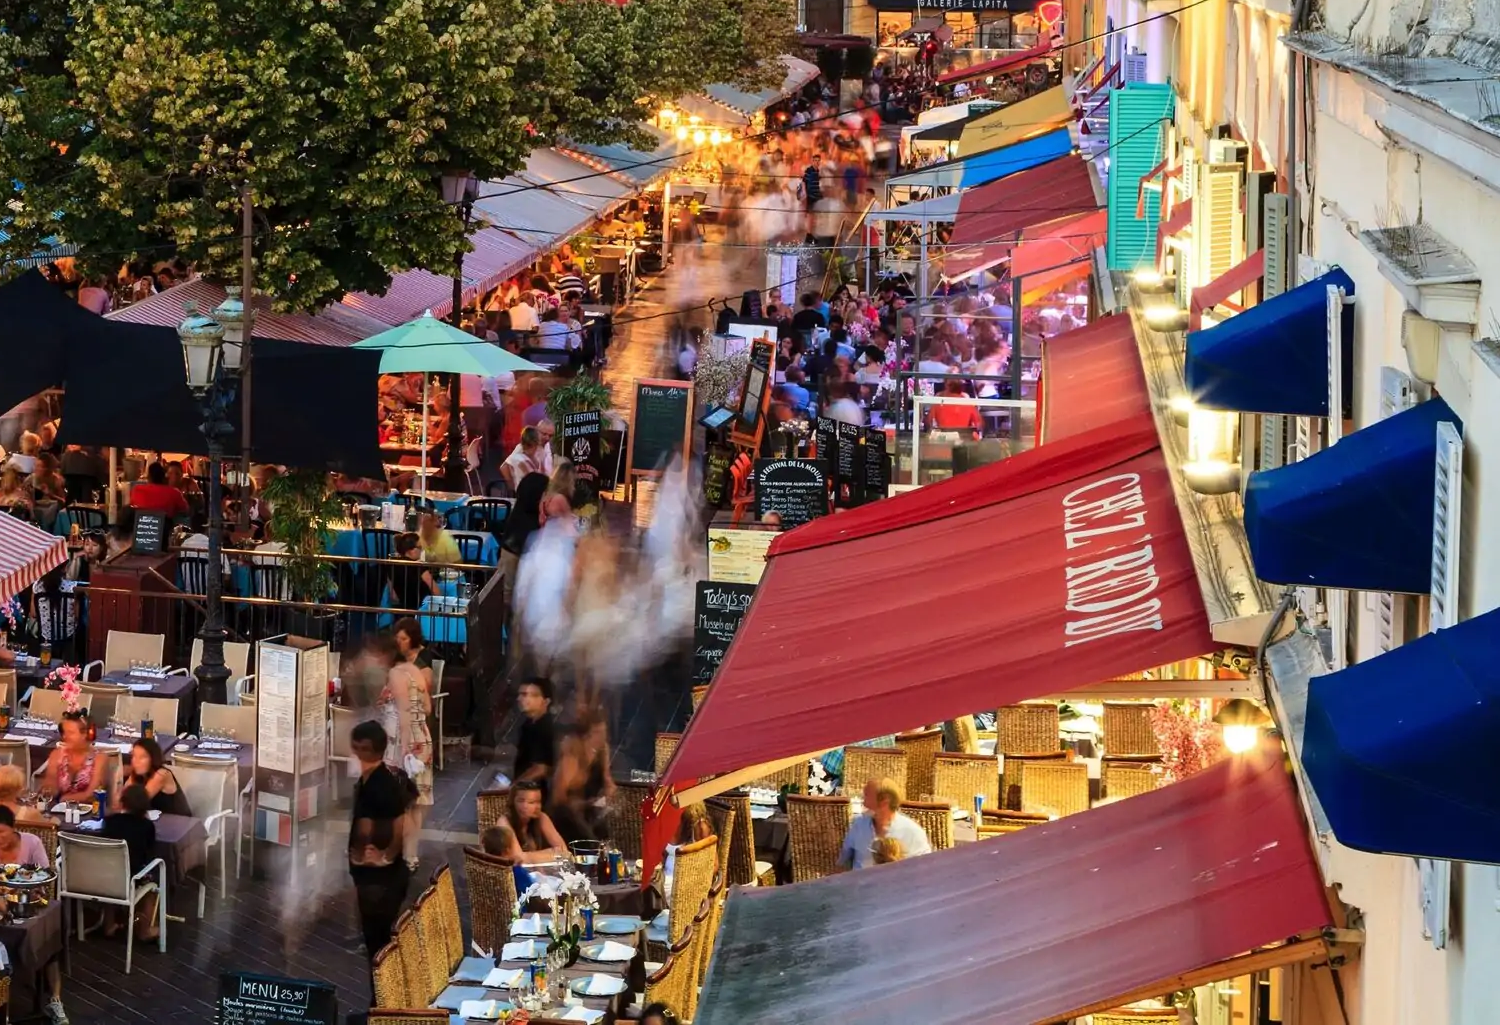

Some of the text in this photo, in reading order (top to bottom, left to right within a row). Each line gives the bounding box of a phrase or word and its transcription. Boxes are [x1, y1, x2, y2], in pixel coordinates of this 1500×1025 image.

[972, 0, 1008, 9] LAPITA
[565, 411, 599, 425] LE FESTIVAL
[564, 423, 600, 437] DE LA MOULE
[762, 461, 787, 475] FESTIVAL
[797, 461, 804, 469] LA
[759, 473, 767, 481] LE
[804, 464, 824, 482] MOULE
[1062, 472, 1148, 550] CHEZ
[703, 588, 738, 613] Today's
[698, 614, 724, 630] Mussels
[242, 982, 279, 1000] MENU
